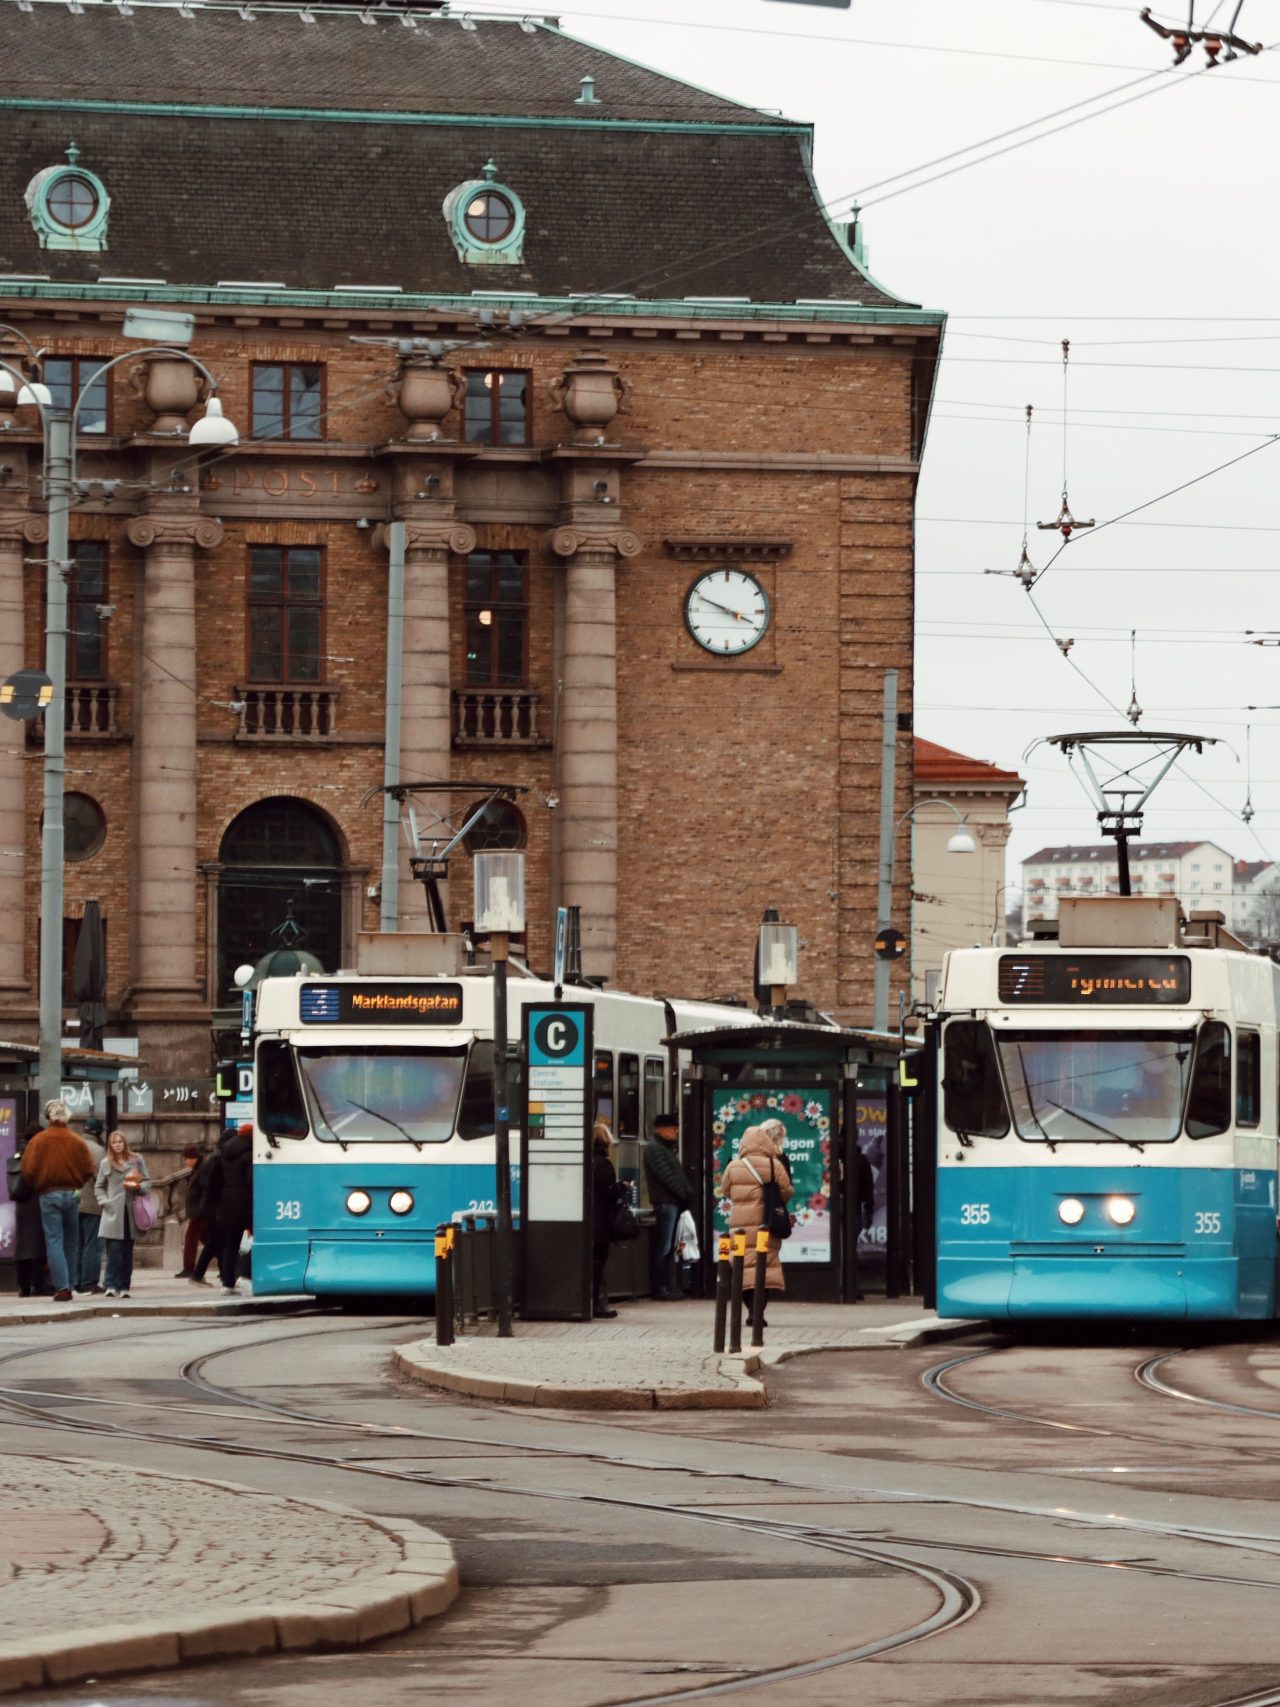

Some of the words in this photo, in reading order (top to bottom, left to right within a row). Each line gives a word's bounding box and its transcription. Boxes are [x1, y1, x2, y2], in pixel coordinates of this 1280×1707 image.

[232, 467, 345, 498] POST
[1012, 965, 1030, 995] 7
[352, 993, 459, 1013] Marklandsgatan
[546, 1021, 567, 1051] C
[240, 1070, 253, 1092] D
[276, 1200, 301, 1221] 343
[960, 1203, 991, 1225] 355
[1194, 1212, 1221, 1235] 355
